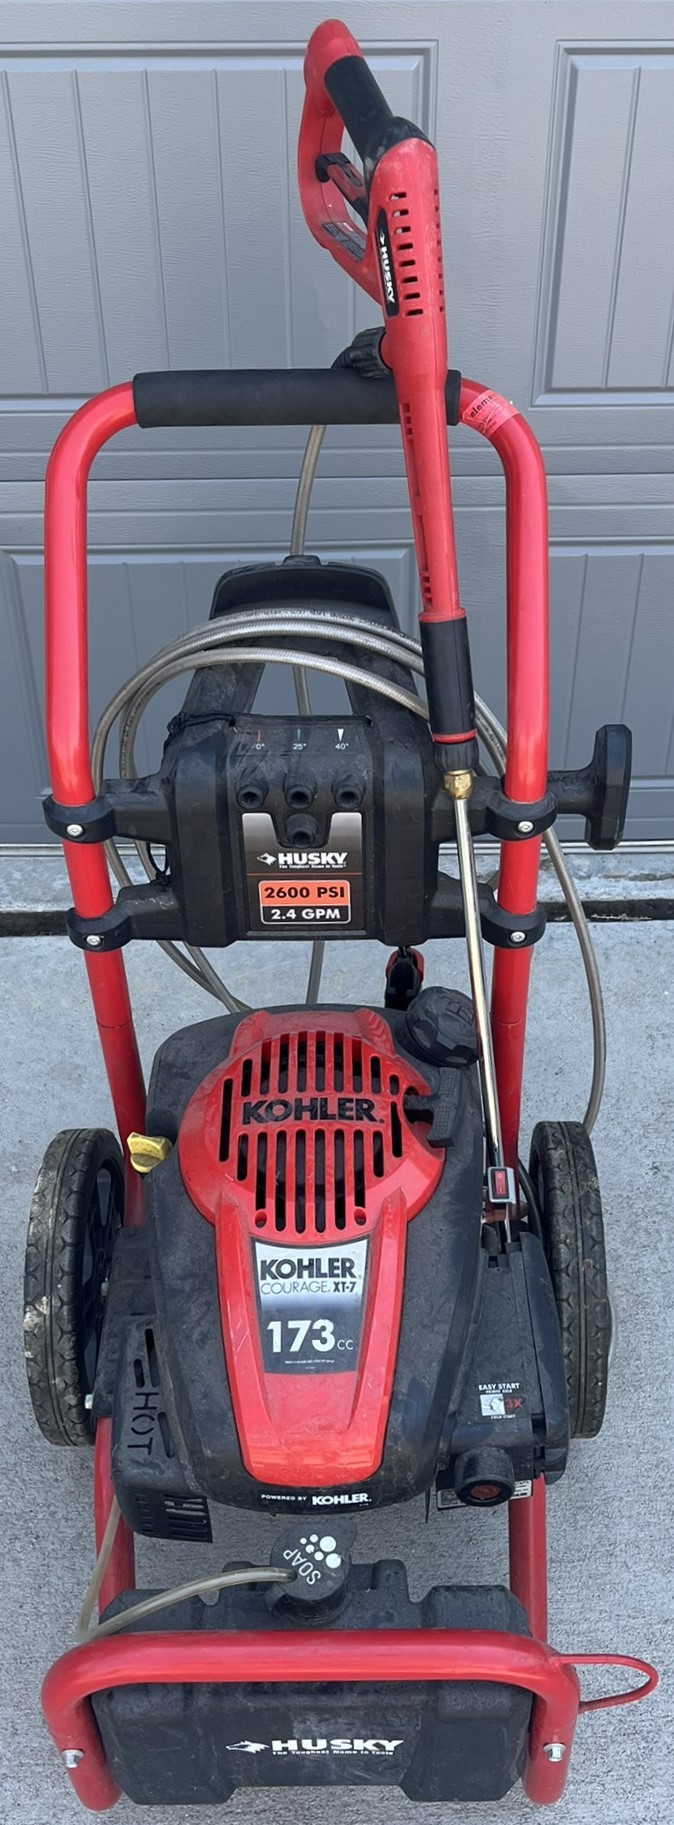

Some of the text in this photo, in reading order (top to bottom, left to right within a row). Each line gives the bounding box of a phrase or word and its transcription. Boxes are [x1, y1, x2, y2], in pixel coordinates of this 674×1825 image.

[380, 246, 396, 304] HUSKY
[278, 852, 348, 865] HUSKY
[264, 886, 345, 899] 2600 PSI
[271, 908, 341, 920] 2.4 GPM
[242, 1097, 379, 1125] KOHLER
[260, 1257, 357, 1280] KOHLER
[260, 1281, 357, 1295] COURAGE XT-7
[266, 1318, 335, 1353] 173
[478, 1382, 520, 1391] EASY START
[505, 1398, 523, 1409] 3X
[127, 1392, 160, 1455] HOT
[311, 1493, 369, 1505] KOHLER
[283, 1548, 321, 1585] SOAP
[271, 1739, 404, 1752] HUSKY
